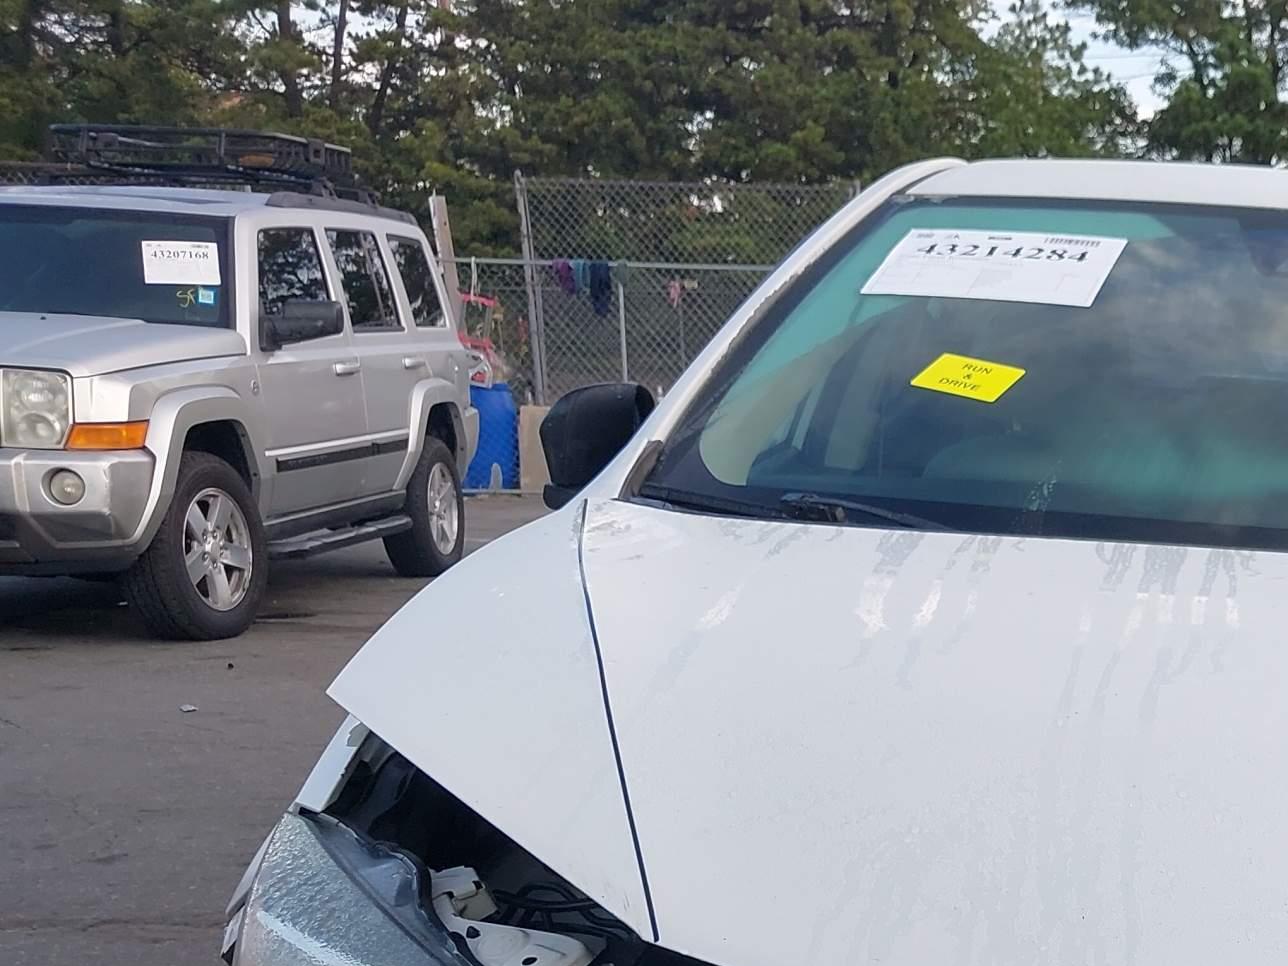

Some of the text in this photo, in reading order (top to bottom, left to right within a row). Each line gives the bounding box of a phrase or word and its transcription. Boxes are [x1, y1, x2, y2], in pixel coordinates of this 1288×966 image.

[151, 250, 209, 259] 43207168
[917, 243, 1088, 263] 43214284
[961, 363, 992, 374] RUN
[939, 377, 982, 391] DRIVE
